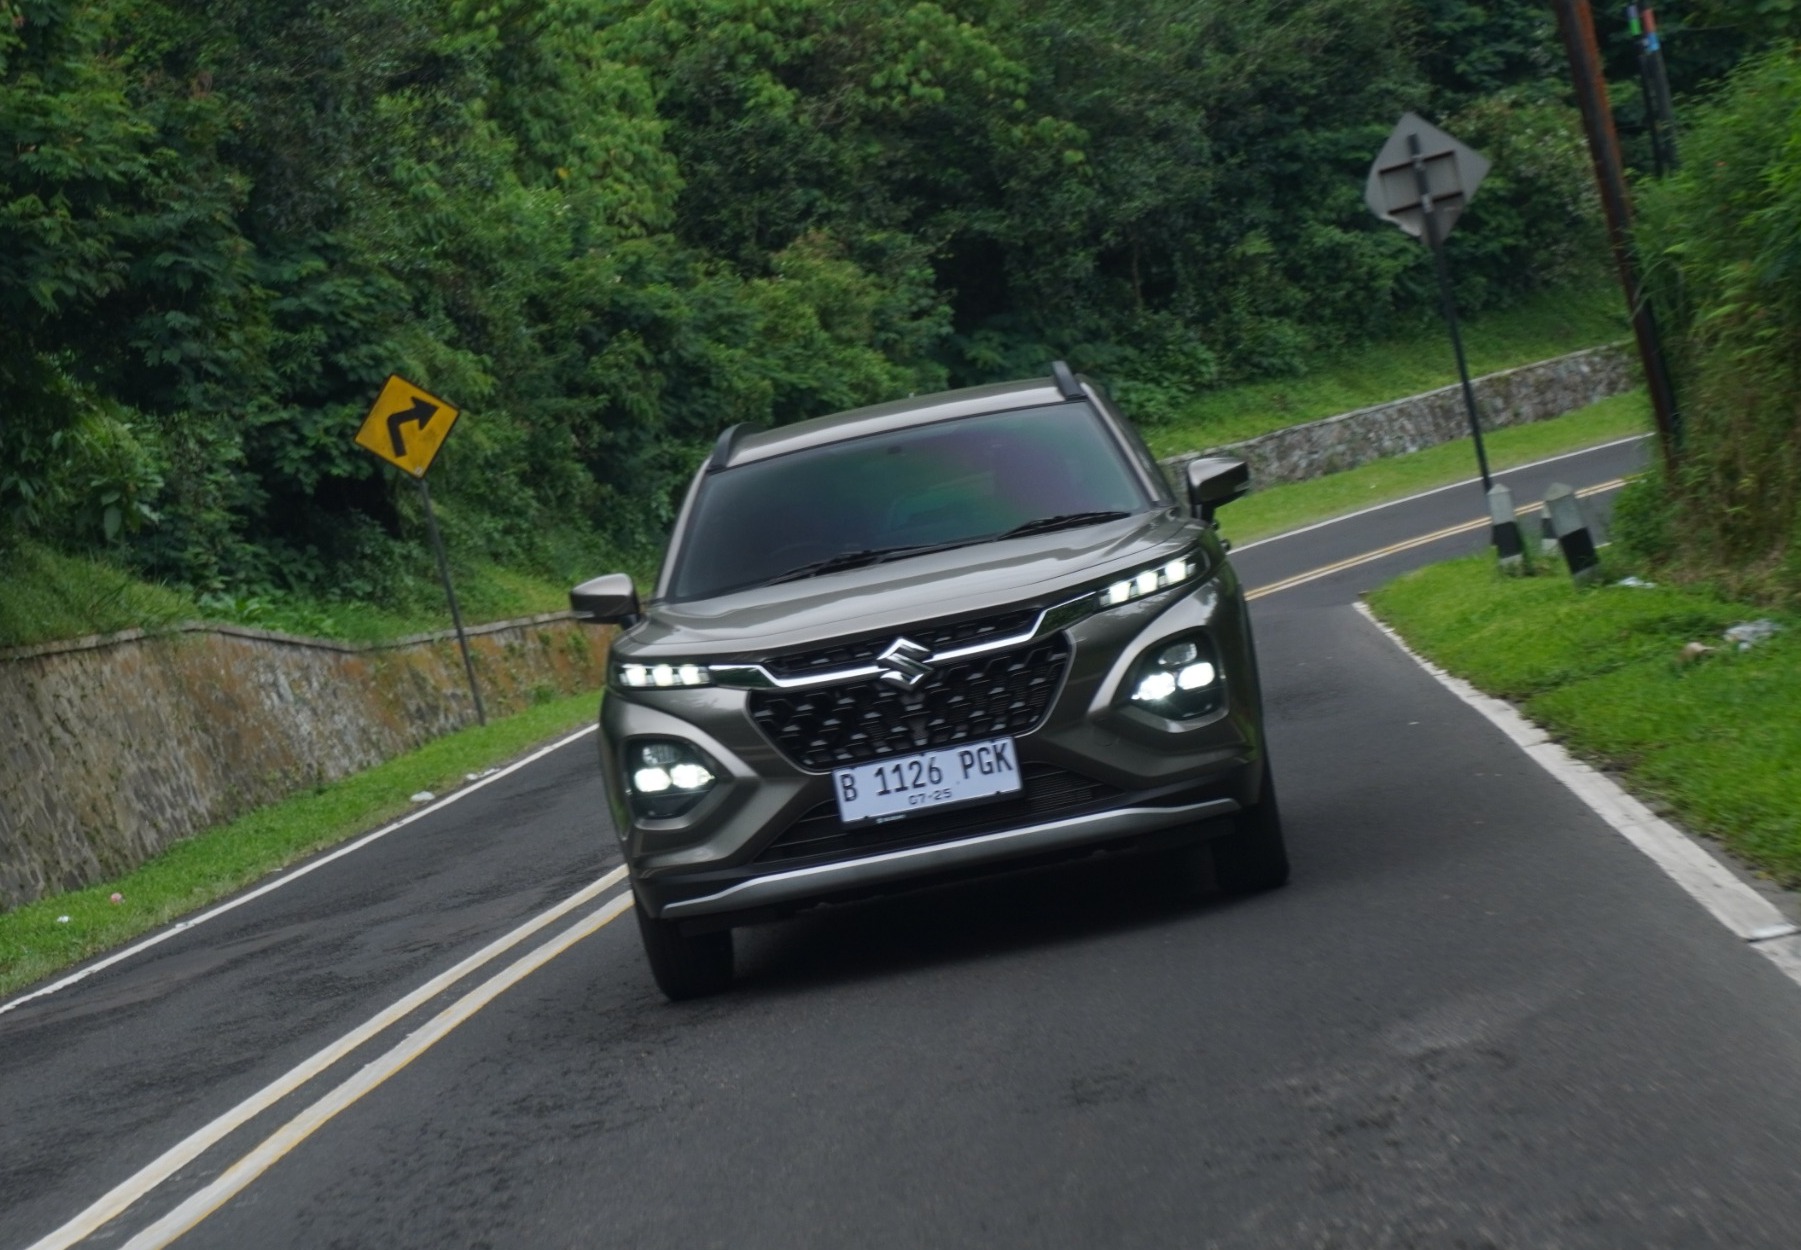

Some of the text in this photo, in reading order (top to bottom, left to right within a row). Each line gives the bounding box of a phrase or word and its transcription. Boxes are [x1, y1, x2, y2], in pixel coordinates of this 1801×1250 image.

[840, 743, 1013, 802] B 1126 PGK
[908, 788, 952, 805] 07-25
